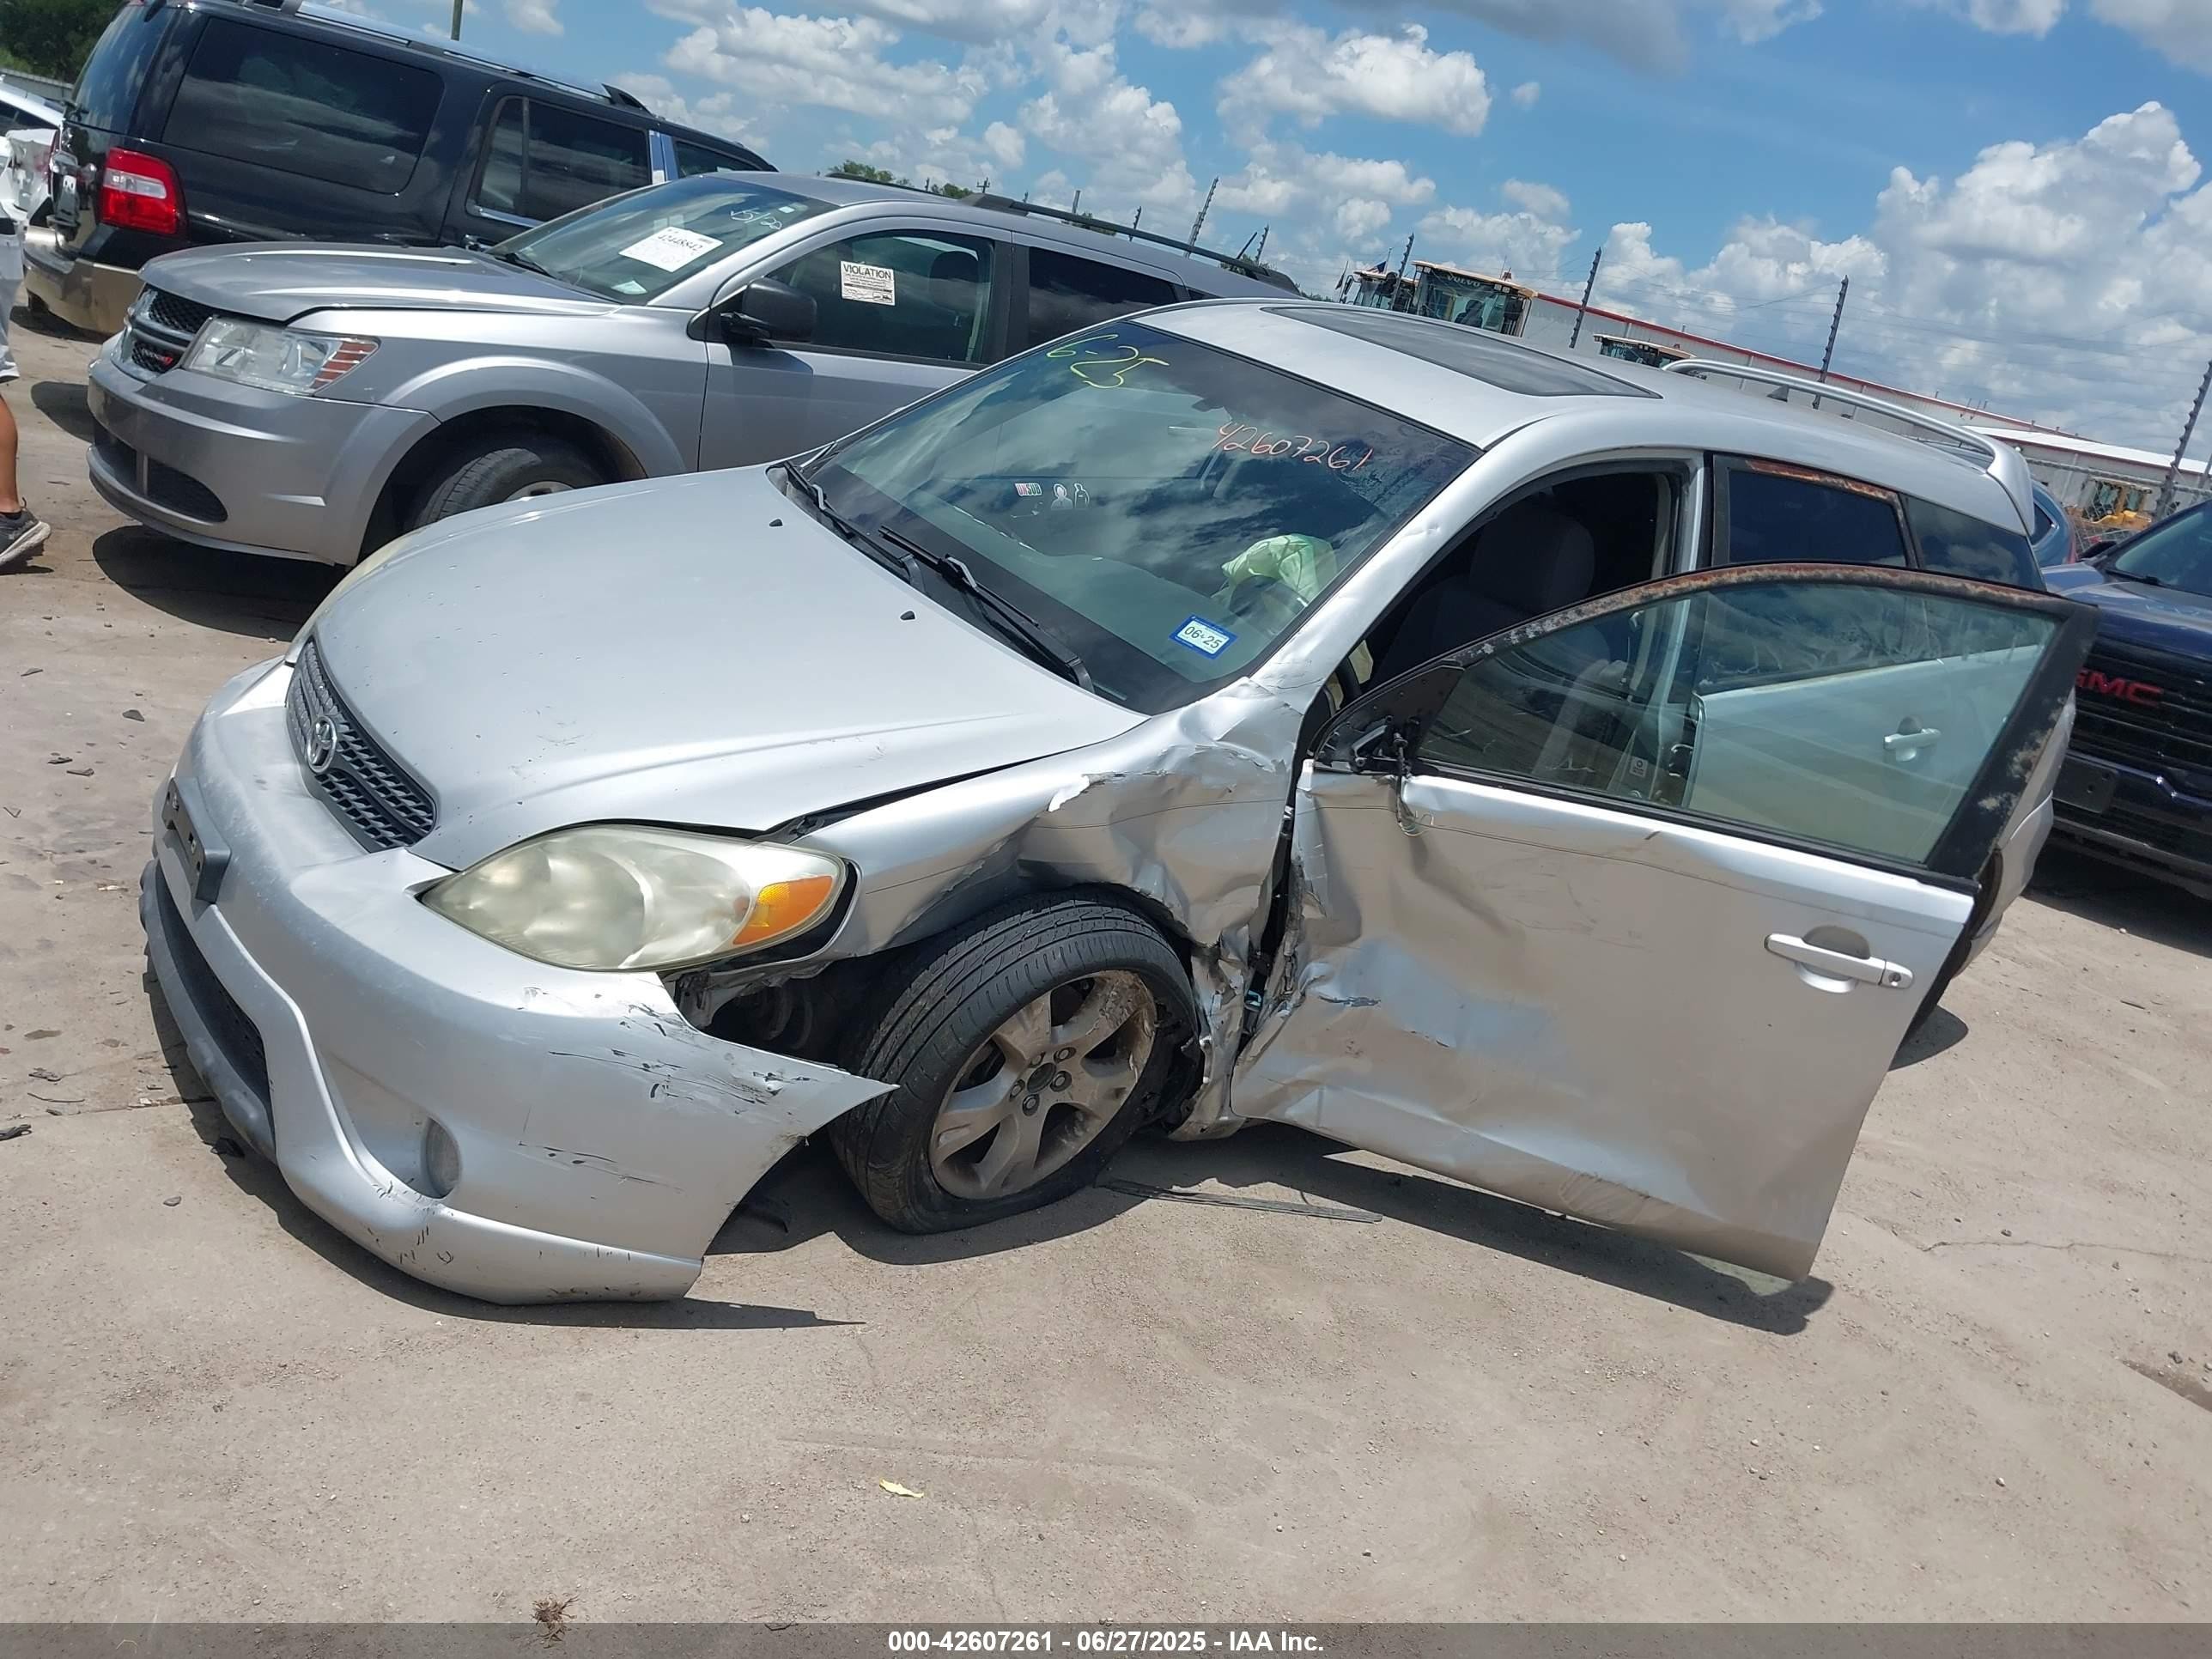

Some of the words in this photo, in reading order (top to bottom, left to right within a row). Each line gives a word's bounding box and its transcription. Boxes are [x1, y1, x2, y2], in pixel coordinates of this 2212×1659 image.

[843, 263, 891, 280] VIOLATION
[1447, 275, 1480, 288] VOLVO
[1212, 421, 1374, 471] 42607261
